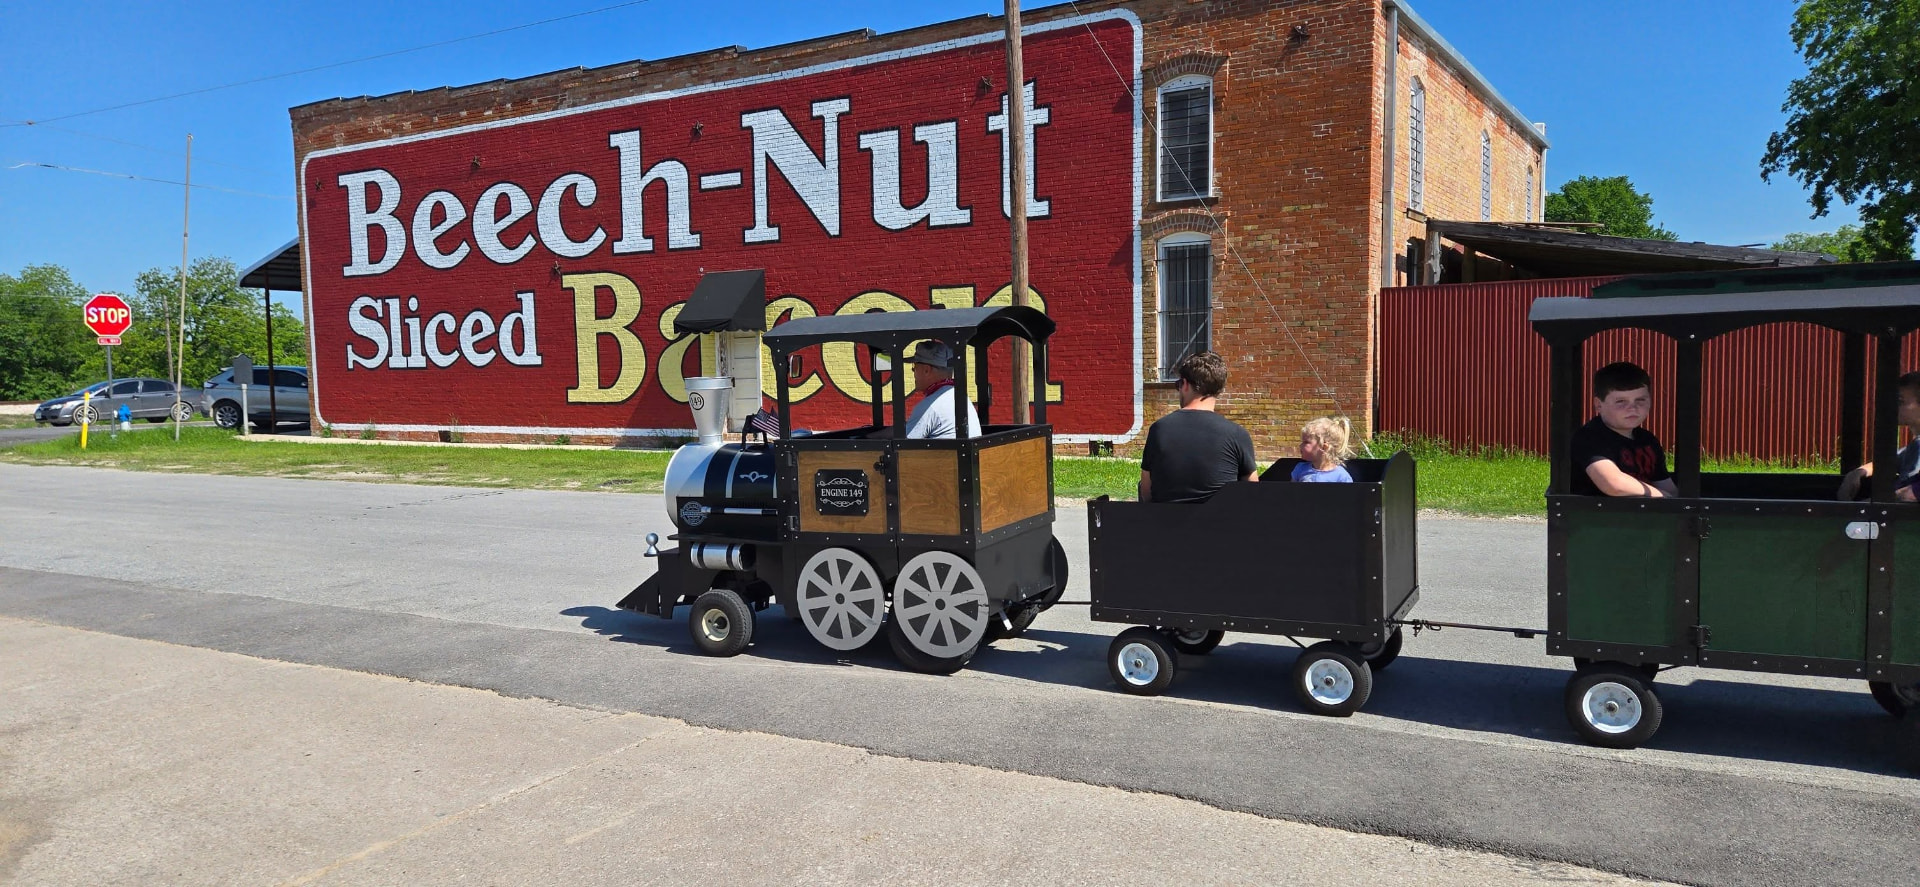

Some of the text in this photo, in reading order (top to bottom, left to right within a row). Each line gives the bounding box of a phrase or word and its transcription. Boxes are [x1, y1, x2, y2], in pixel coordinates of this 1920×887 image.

[337, 79, 1051, 278] Beech-Nut
[87, 306, 129, 324] STOP
[346, 290, 543, 370] Sliced
[821, 488, 863, 498] ENGINE 149
